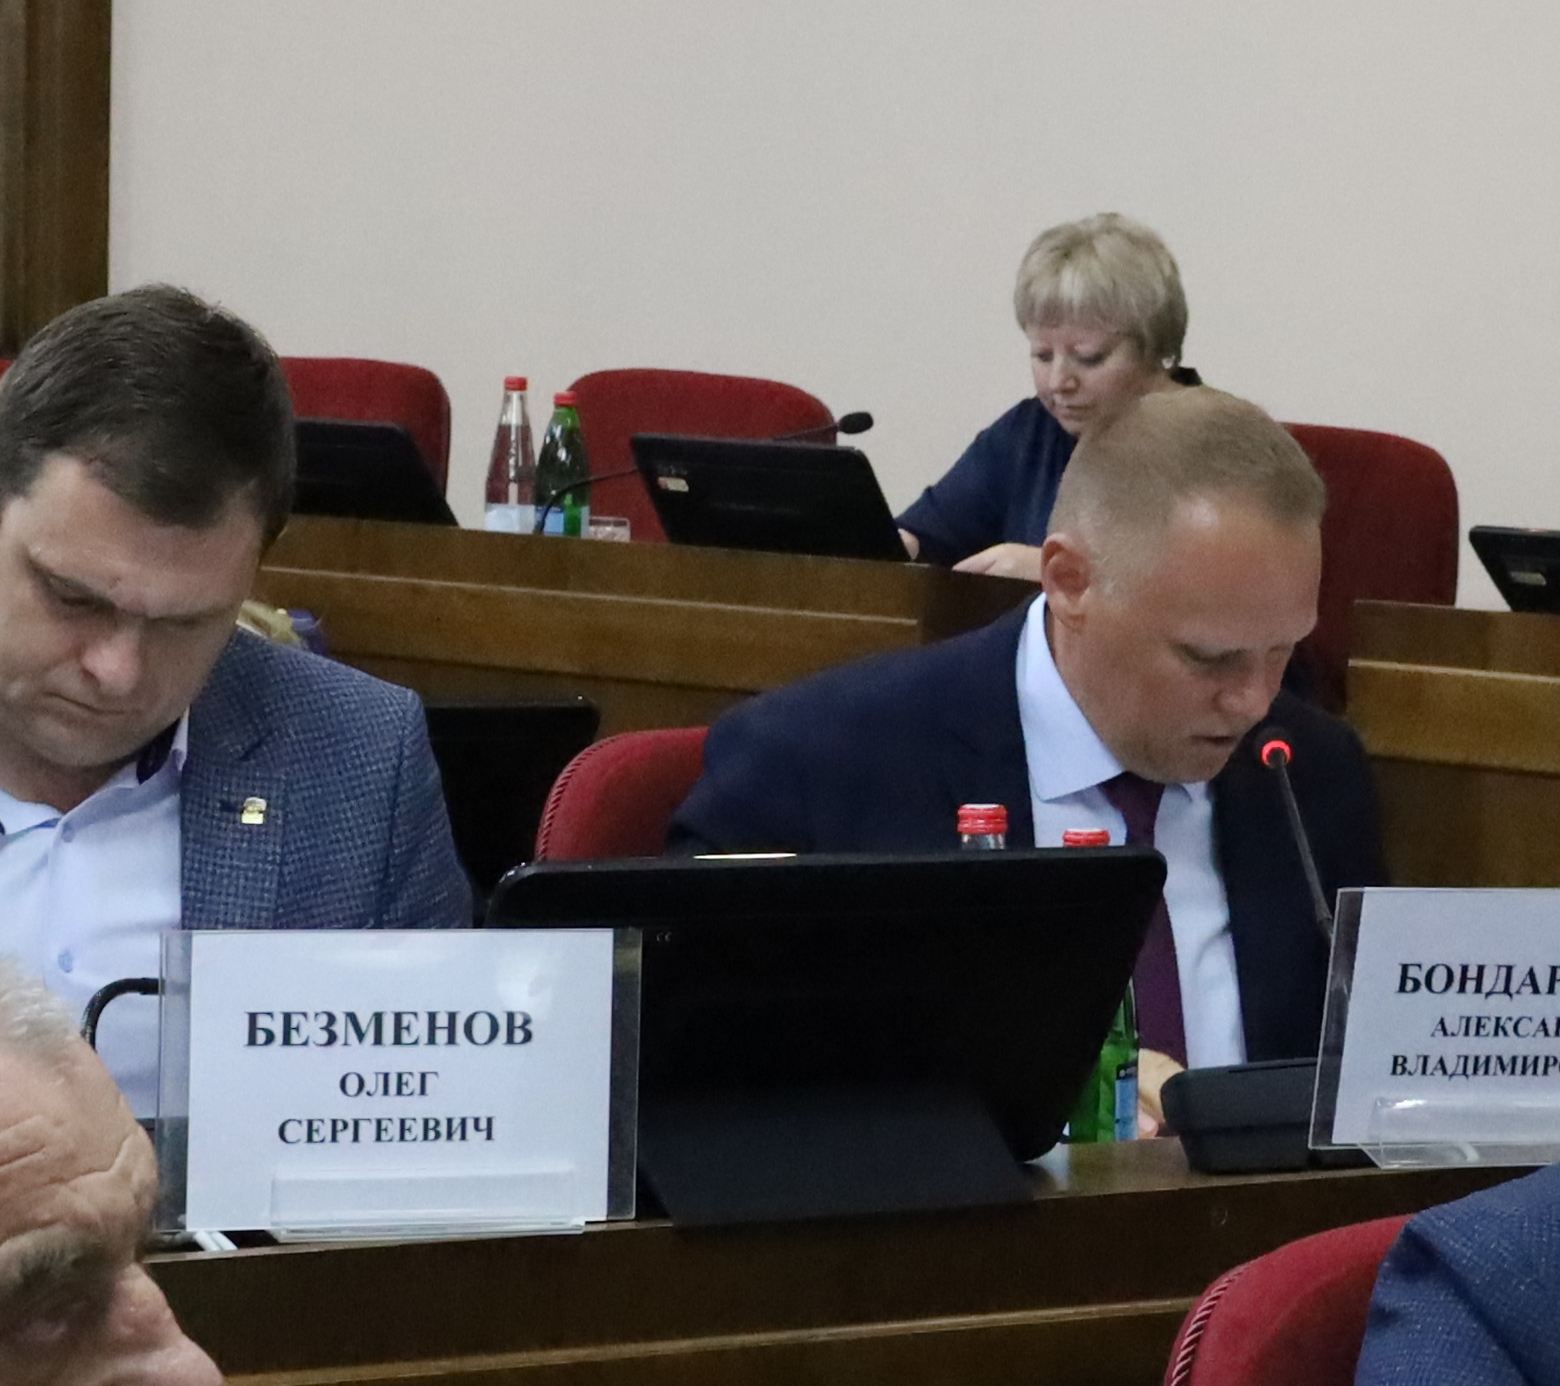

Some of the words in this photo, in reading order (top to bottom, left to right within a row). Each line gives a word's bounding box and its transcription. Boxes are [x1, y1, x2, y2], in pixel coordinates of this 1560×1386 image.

[246, 1011, 532, 1047] БЕЗМЕНОВ
[340, 1072, 437, 1097] ОЛЕГ
[279, 1117, 492, 1144] СЕРГЕЕВИЧ
